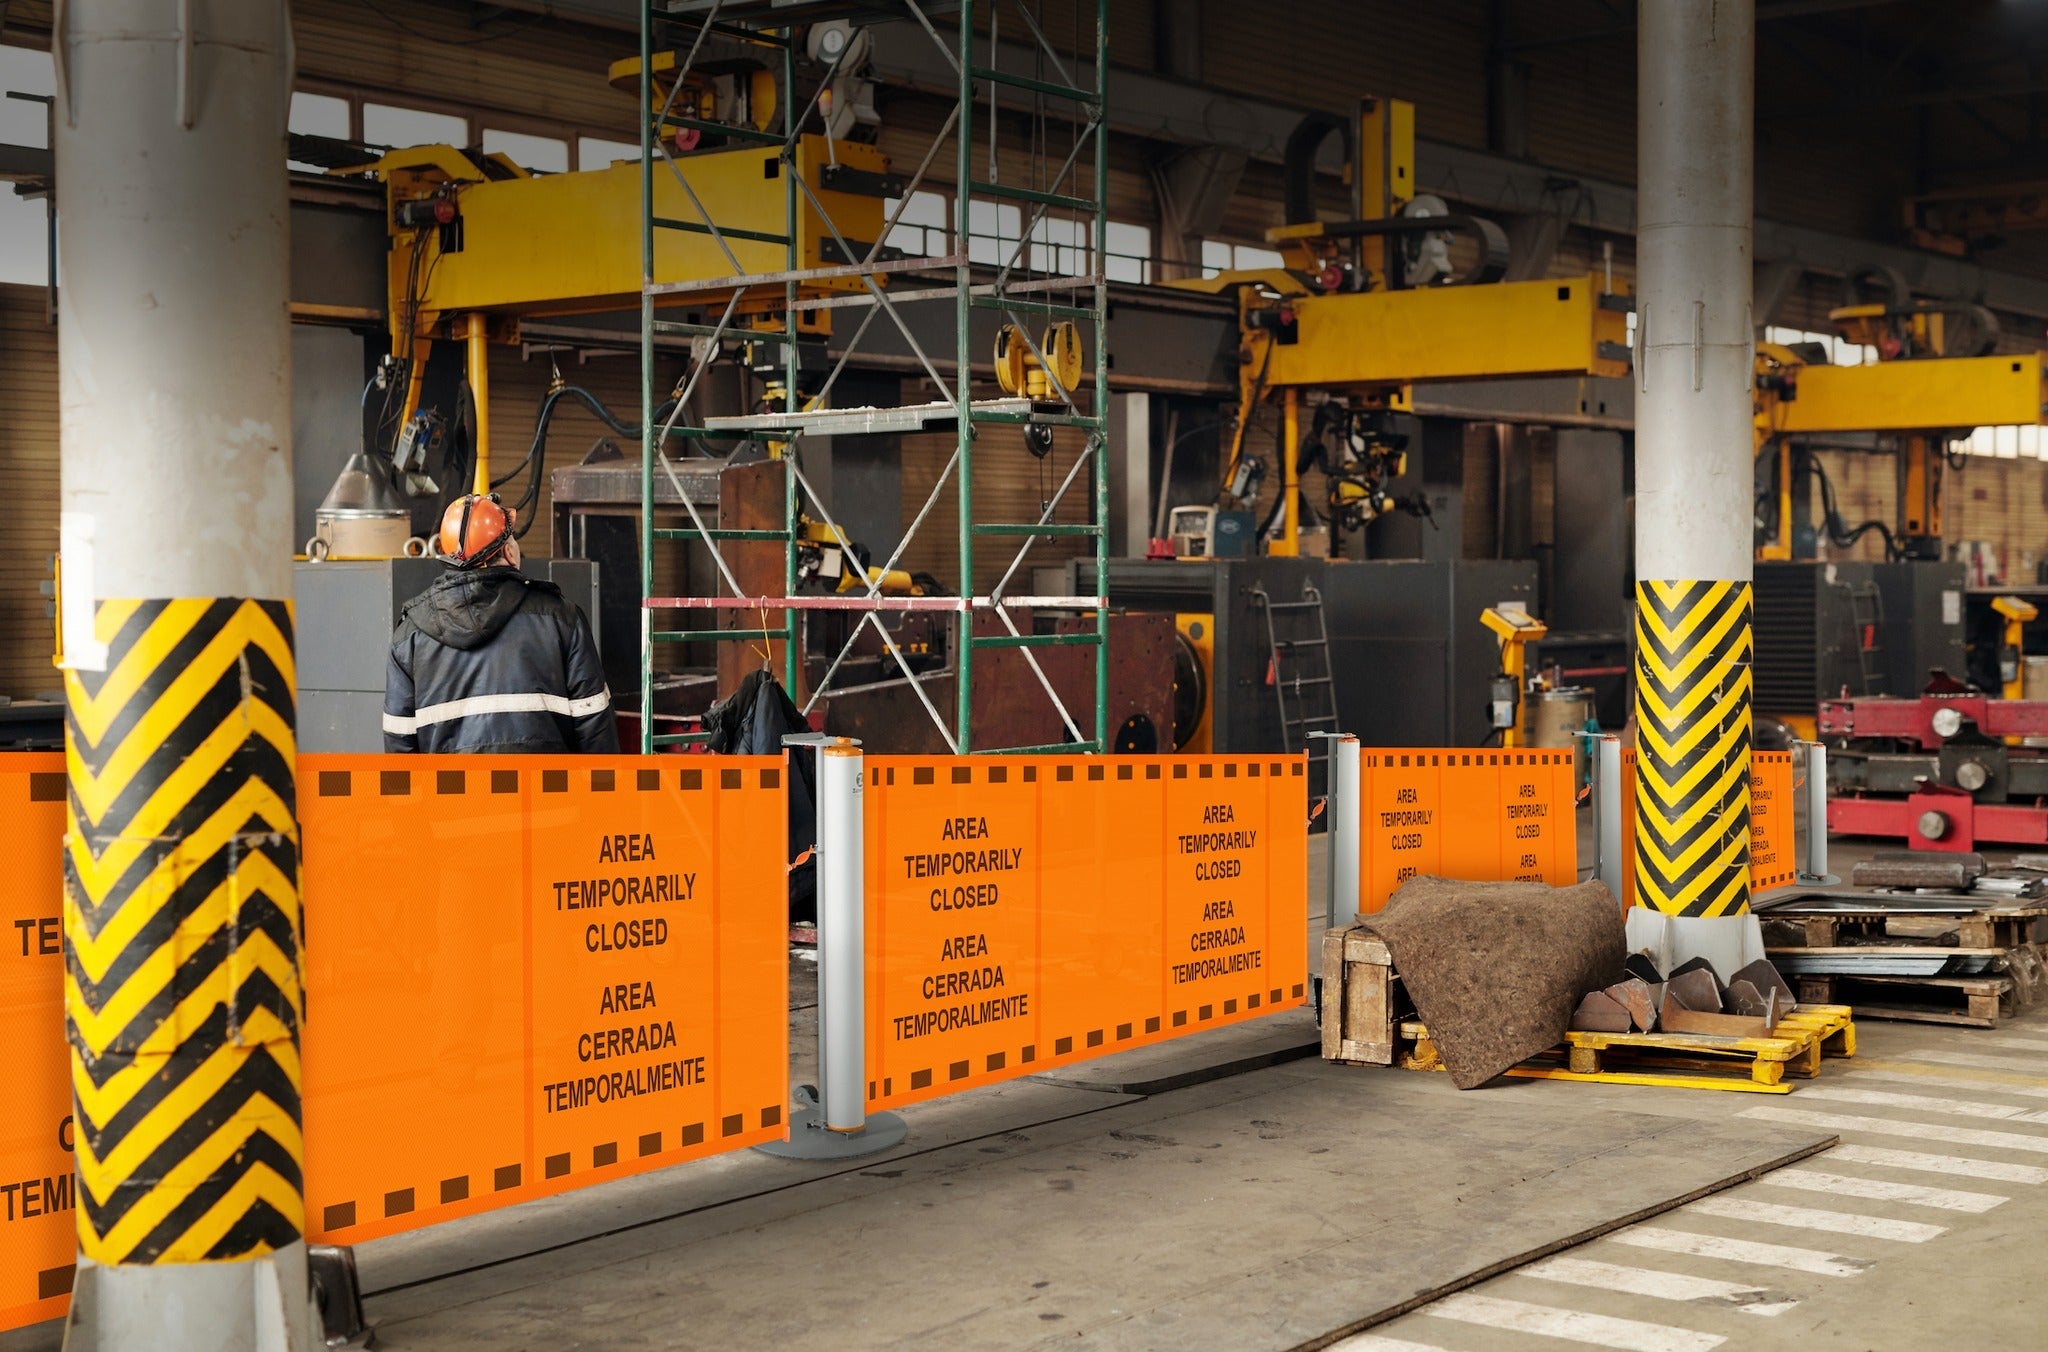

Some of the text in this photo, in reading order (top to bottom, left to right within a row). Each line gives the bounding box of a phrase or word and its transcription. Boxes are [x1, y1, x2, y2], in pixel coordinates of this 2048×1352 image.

[1397, 788, 1417, 804] AREA
[1519, 784, 1536, 798] AREA
[1203, 805, 1234, 823] AREA
[1381, 810, 1432, 827] TEMPORARILY
[1506, 803, 1548, 819] TEMPORARILY
[943, 817, 988, 840] AREA
[1515, 824, 1541, 839] CLOSED
[600, 834, 655, 863] AREA
[1179, 831, 1256, 853] TEMPORARILY
[1391, 833, 1422, 850] CLOSED
[904, 848, 1021, 878] TEMPORARILY
[1195, 860, 1240, 880] CLOSED
[1520, 854, 1537, 868] AREA
[1396, 866, 1418, 884] AREA
[554, 874, 695, 910] TEMPORARILY
[931, 884, 997, 911] CLOSED
[1203, 901, 1234, 921] AREA
[586, 919, 667, 952] CLOSED
[942, 934, 987, 961] AREA
[1191, 927, 1245, 951] CERRADA
[1172, 951, 1261, 984] TEMPORALMENTE
[923, 966, 1004, 999] CERRADA
[600, 982, 656, 1014] AREA
[894, 995, 1027, 1040] TEMPORALMENTE
[579, 1021, 676, 1062] CERRADA
[544, 1057, 704, 1113] TEMPORALMENTE
[0, 1173, 75, 1221] TEM
